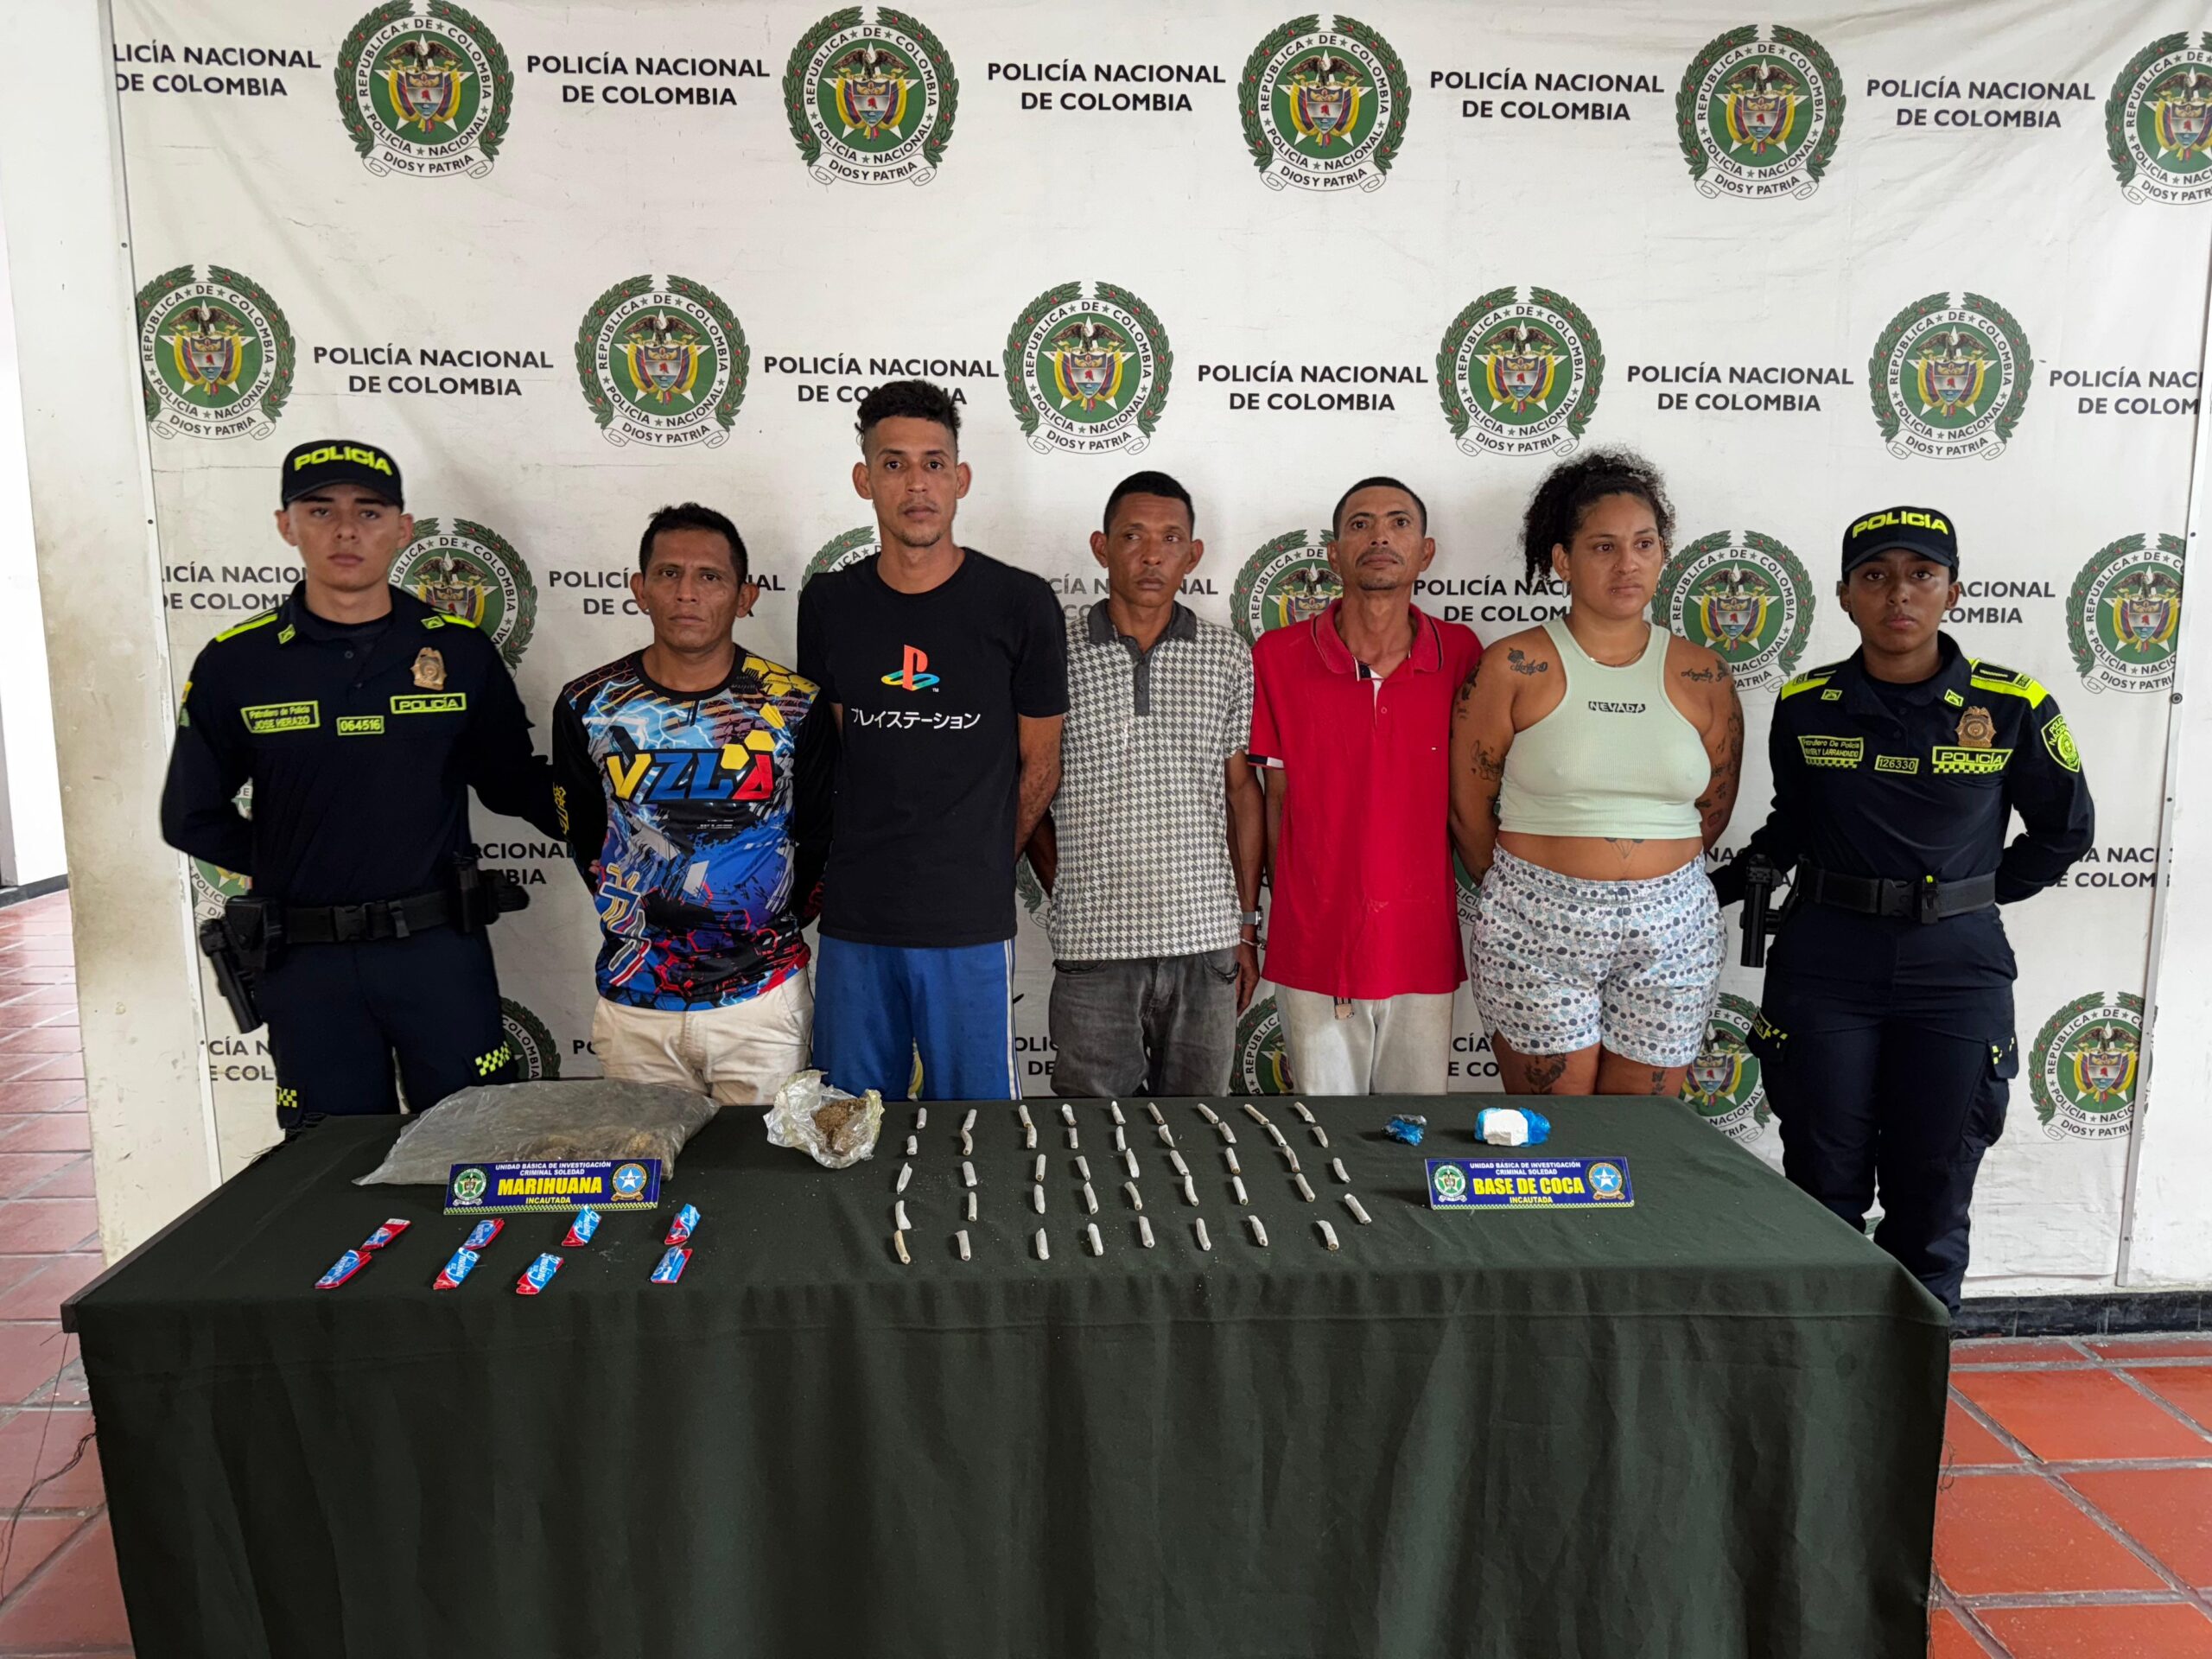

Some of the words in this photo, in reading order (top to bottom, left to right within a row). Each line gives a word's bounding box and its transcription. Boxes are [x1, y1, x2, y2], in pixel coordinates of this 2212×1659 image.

[112, 39, 175, 63] LICÍA
[184, 47, 321, 68] NACIONAL
[528, 52, 628, 74] POLICÍA
[636, 58, 770, 77] NACIONAL
[863, 28, 880, 37] DE
[896, 35, 937, 107] COLOMBIA
[988, 59, 1086, 81] POLICÍA
[1095, 65, 1225, 83] NACIONAL
[116, 73, 144, 91] DE
[153, 74, 287, 96] COLOMBIA
[1431, 68, 1527, 90] POLICÍA
[1535, 73, 1664, 92] NACIONAL
[1758, 44, 1775, 54] DE
[1789, 53, 1824, 123] COLOMBIA
[1867, 76, 1961, 98] POLICÍA
[1968, 82, 2095, 99] NACIONAL
[563, 86, 594, 103] DE
[602, 86, 737, 105] COLOMBIA
[1022, 92, 1052, 110] DE
[1060, 93, 1192, 111] COLOMBIA
[1463, 100, 1492, 118] DE
[1501, 101, 1630, 120] COLOMBIA
[1897, 109, 1927, 125] DE
[1935, 110, 2061, 127] COLOMBIA
[874, 122, 931, 164] NACIONAL
[1758, 137, 1816, 178] NACIONAL
[874, 162, 918, 181] PATRIA
[1757, 176, 1800, 194] PATRIA
[197, 286, 214, 295] DE
[229, 294, 271, 363] COLOMBIA
[1082, 302, 1099, 311] DE
[1113, 310, 1152, 378] COLOMBIA
[1948, 312, 1965, 321] DE
[1978, 320, 2012, 386] COLOMBIA
[315, 343, 412, 365] POLICÍA
[421, 349, 553, 368] NACIONAL
[765, 353, 862, 374] POLICÍA
[870, 359, 999, 377] NACIONAL
[1198, 361, 1293, 382] POLICÍA
[1301, 366, 1428, 383] NACIONAL
[1628, 362, 1721, 383] POLICÍA
[1730, 367, 1853, 385] NACIONAL
[2050, 366, 2142, 387] POLICÍA
[2149, 371, 2202, 388] NACI
[350, 376, 381, 392] DE
[388, 377, 522, 395] COLOMBIA
[798, 385, 829, 402] DE
[213, 378, 268, 419] NACIONAL
[1230, 393, 1259, 410] DE
[1268, 393, 1395, 410] COLOMBIA
[1658, 393, 1688, 410] DE
[1695, 394, 1821, 411] COLOMBIA
[2078, 397, 2107, 414] DE
[2114, 398, 2199, 415] COLOM
[1090, 393, 1146, 434] NACIONAL
[1948, 400, 2004, 440] NACIONAL
[214, 416, 257, 435] PATRIA
[1090, 431, 1132, 450] PATRIA
[1947, 437, 1988, 455] PATRIA
[1306, 549, 1324, 557] DE
[162, 561, 214, 582] ICÍA
[222, 566, 306, 583] NACIO
[440, 537, 458, 547] DE
[473, 545, 515, 612] COLOMBIA
[549, 568, 629, 588] POLICÍ
[1414, 575, 1507, 596] POLICÍA
[1730, 550, 1747, 558] DE
[1760, 556, 1795, 621] COLOMBIA
[1959, 582, 2056, 598] ACIONAL
[190, 593, 291, 610] COLOM
[583, 598, 614, 614] DE
[1445, 606, 1473, 622] DE
[1481, 606, 1570, 622] COLOM
[1941, 607, 2023, 623] OMBIA
[1732, 634, 1787, 673] NACIONAL
[399, 697, 459, 710] POLICÍA
[1588, 701, 1646, 713] NEVADA
[340, 718, 381, 732] 064516
[1878, 758, 1916, 770] 126330
[1941, 753, 2002, 764] POLICÍA
[606, 753, 773, 801] VZLA
[2107, 847, 2159, 863] NACI
[2075, 872, 2156, 887] COLOM
[1028, 1061, 1055, 1075] DE
[498, 1177, 602, 1196] MARIHUANA
[1472, 1178, 1515, 1195] BASE
[1516, 1178, 1538, 1194] DE
[1539, 1177, 1585, 1194] COCA
